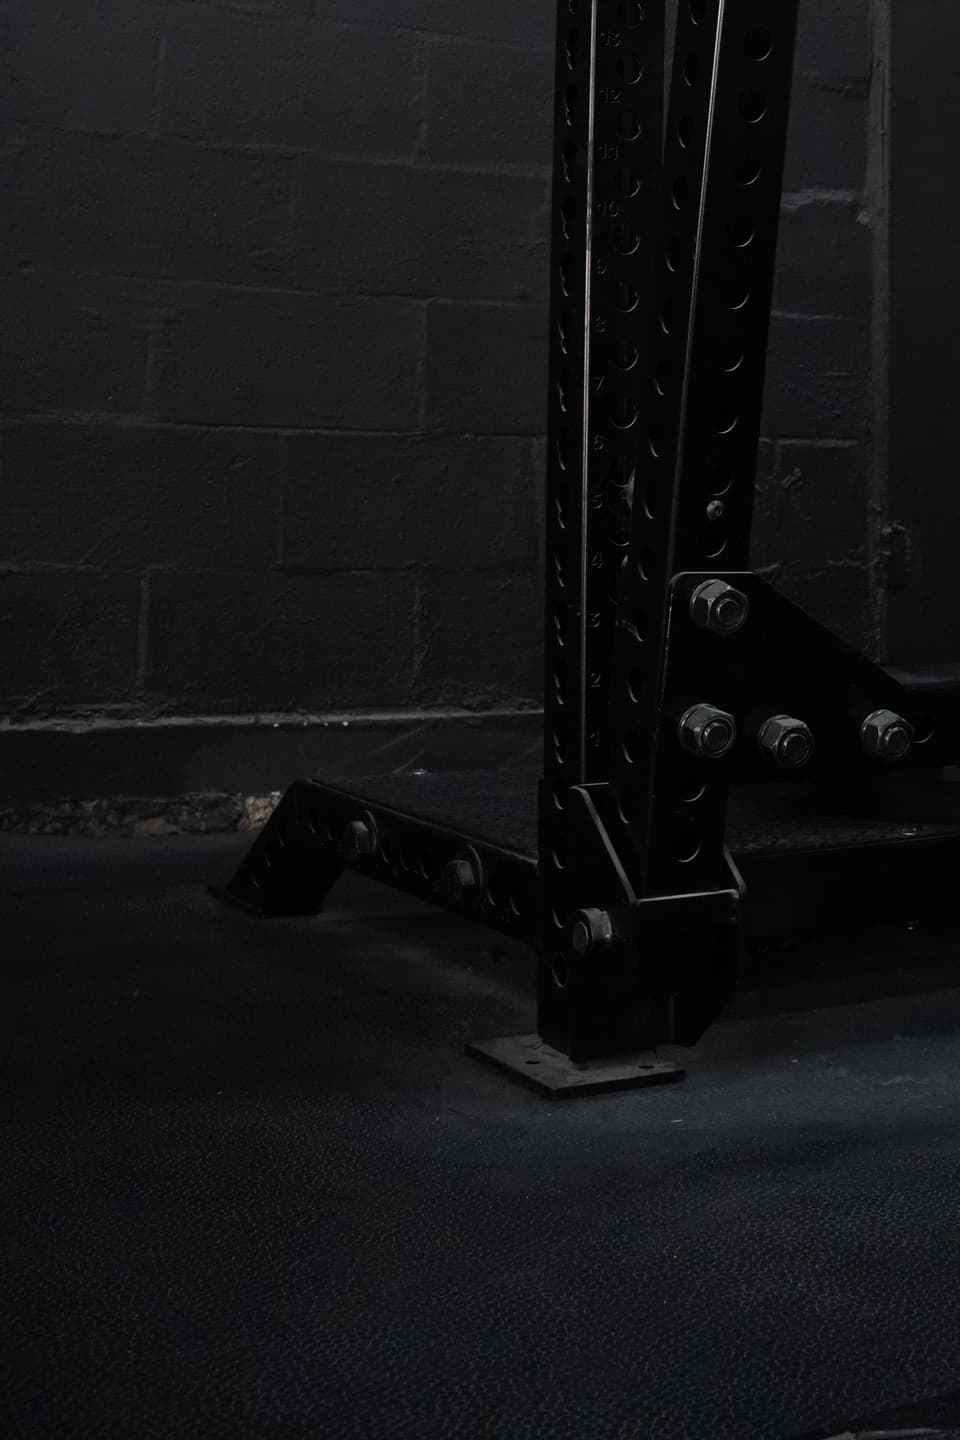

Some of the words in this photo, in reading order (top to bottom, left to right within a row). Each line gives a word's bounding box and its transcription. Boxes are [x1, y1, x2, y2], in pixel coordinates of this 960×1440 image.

[599, 87, 622, 104] 12
[597, 200, 620, 217] 10
[592, 375, 605, 392] 7
[591, 551, 605, 569] 4
[590, 672, 601, 688] 2
